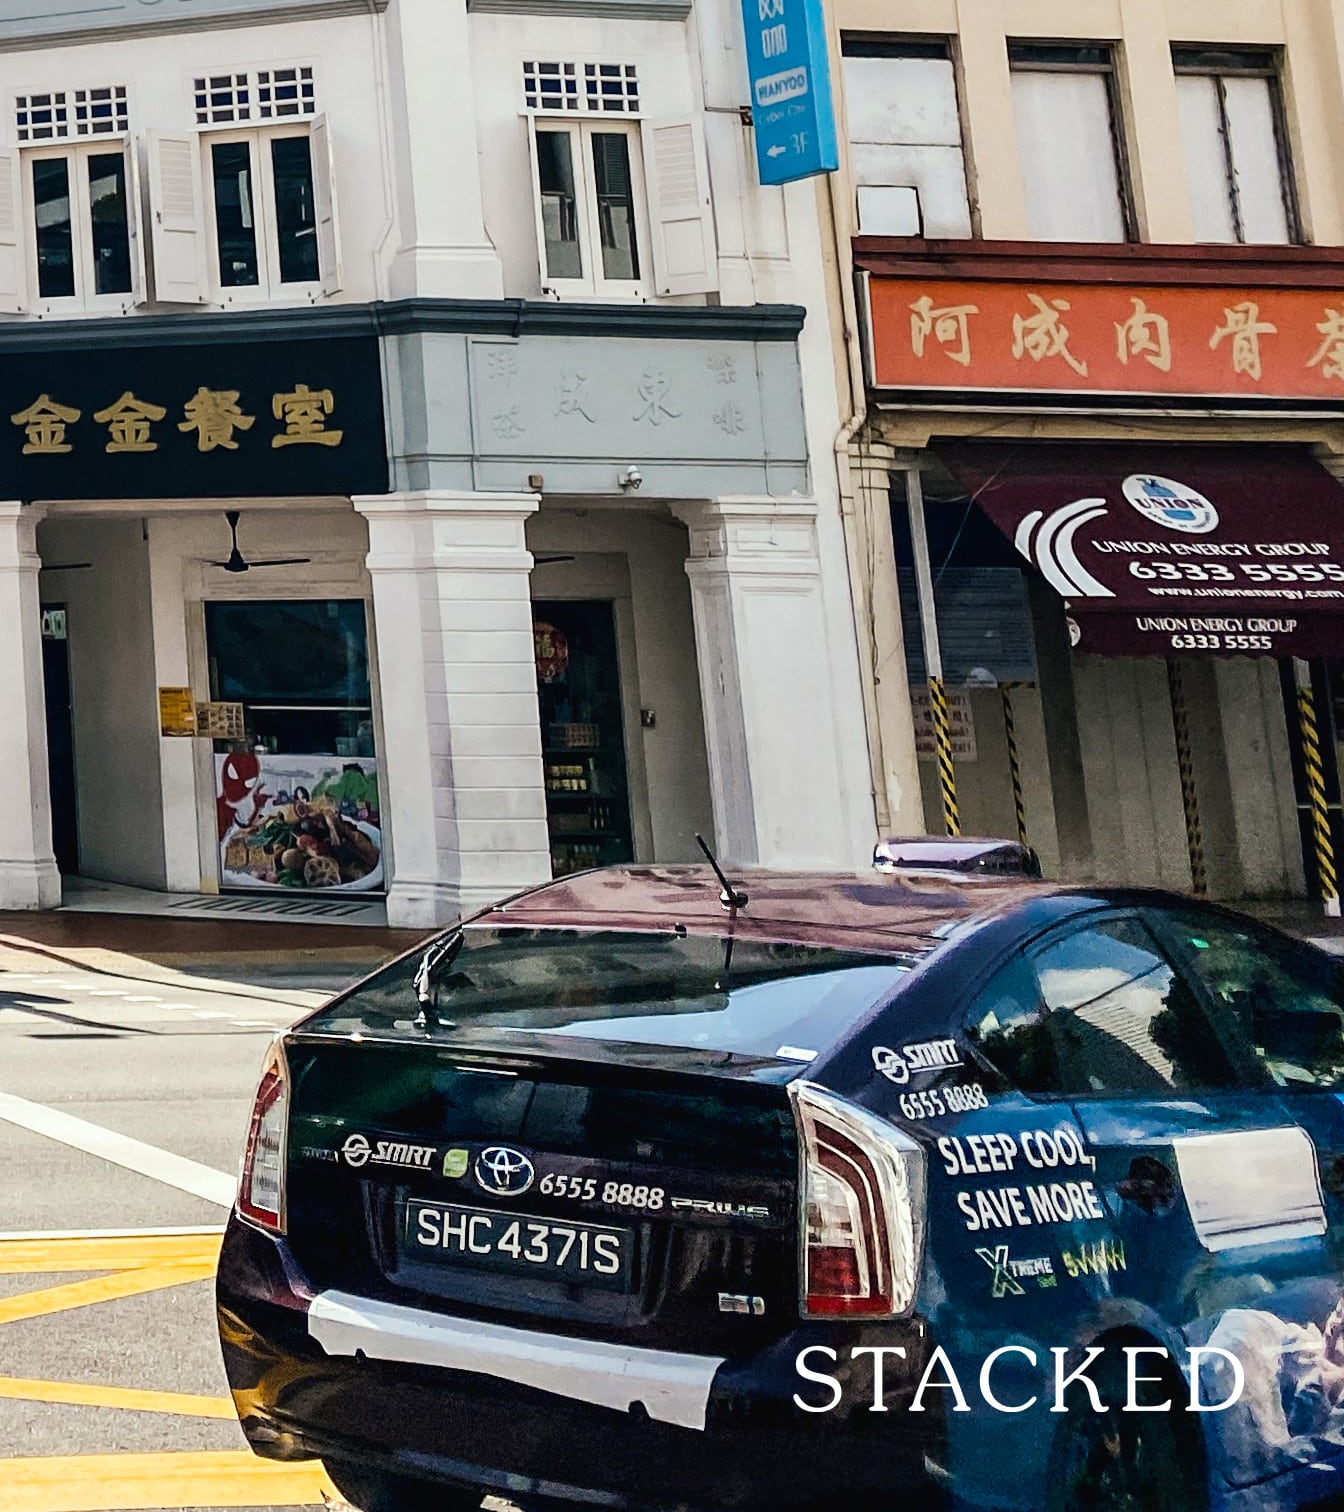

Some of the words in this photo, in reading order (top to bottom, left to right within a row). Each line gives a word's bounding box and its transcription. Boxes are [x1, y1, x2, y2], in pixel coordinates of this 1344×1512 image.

[758, 74, 805, 99] WANYOO
[10, 383, 345, 455] 金金餐室
[1133, 497, 1206, 509] UNION
[1091, 539, 1171, 554] UNION
[1172, 541, 1253, 556] ENERGY
[1254, 542, 1331, 557] GROUP
[1128, 561, 1236, 581] 6333
[1239, 562, 1344, 583] 5555
[1135, 617, 1189, 632] UNION
[1190, 617, 1244, 633] ENERGY
[1246, 618, 1298, 633] GROUP
[1170, 634, 1221, 649] 6333
[1224, 634, 1272, 650] 5555
[902, 1038, 961, 1070] SMRT
[899, 1089, 946, 1120] 6555
[943, 1083, 989, 1114] 8888
[370, 1140, 437, 1169] SMRT
[937, 1133, 1018, 1176] SLEEP
[1019, 1127, 1097, 1174] COOL,
[538, 1173, 597, 1201] 6555
[601, 1181, 665, 1210] 8888
[670, 1196, 770, 1218] PRIUS
[957, 1187, 1032, 1231] SAVE
[1026, 1180, 1104, 1225] MORE
